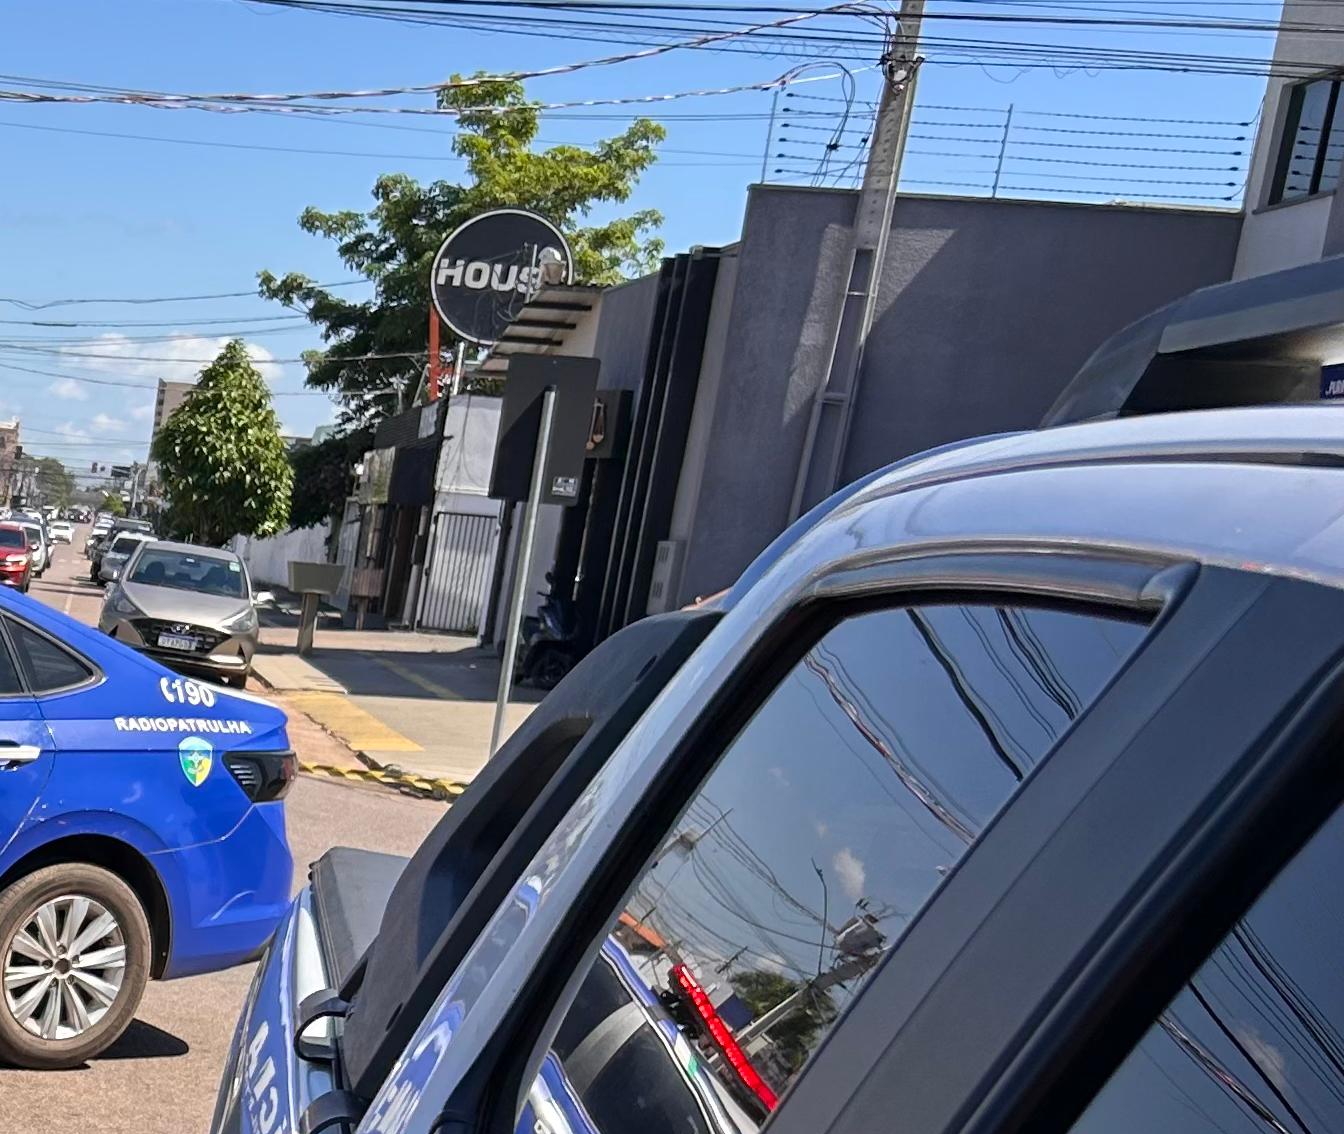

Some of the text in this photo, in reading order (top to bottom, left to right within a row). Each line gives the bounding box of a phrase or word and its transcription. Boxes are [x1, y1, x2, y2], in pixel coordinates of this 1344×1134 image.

[437, 258, 542, 294] HOUS
[171, 679, 216, 707] 190
[114, 717, 252, 734] RADIOPATRULHA
